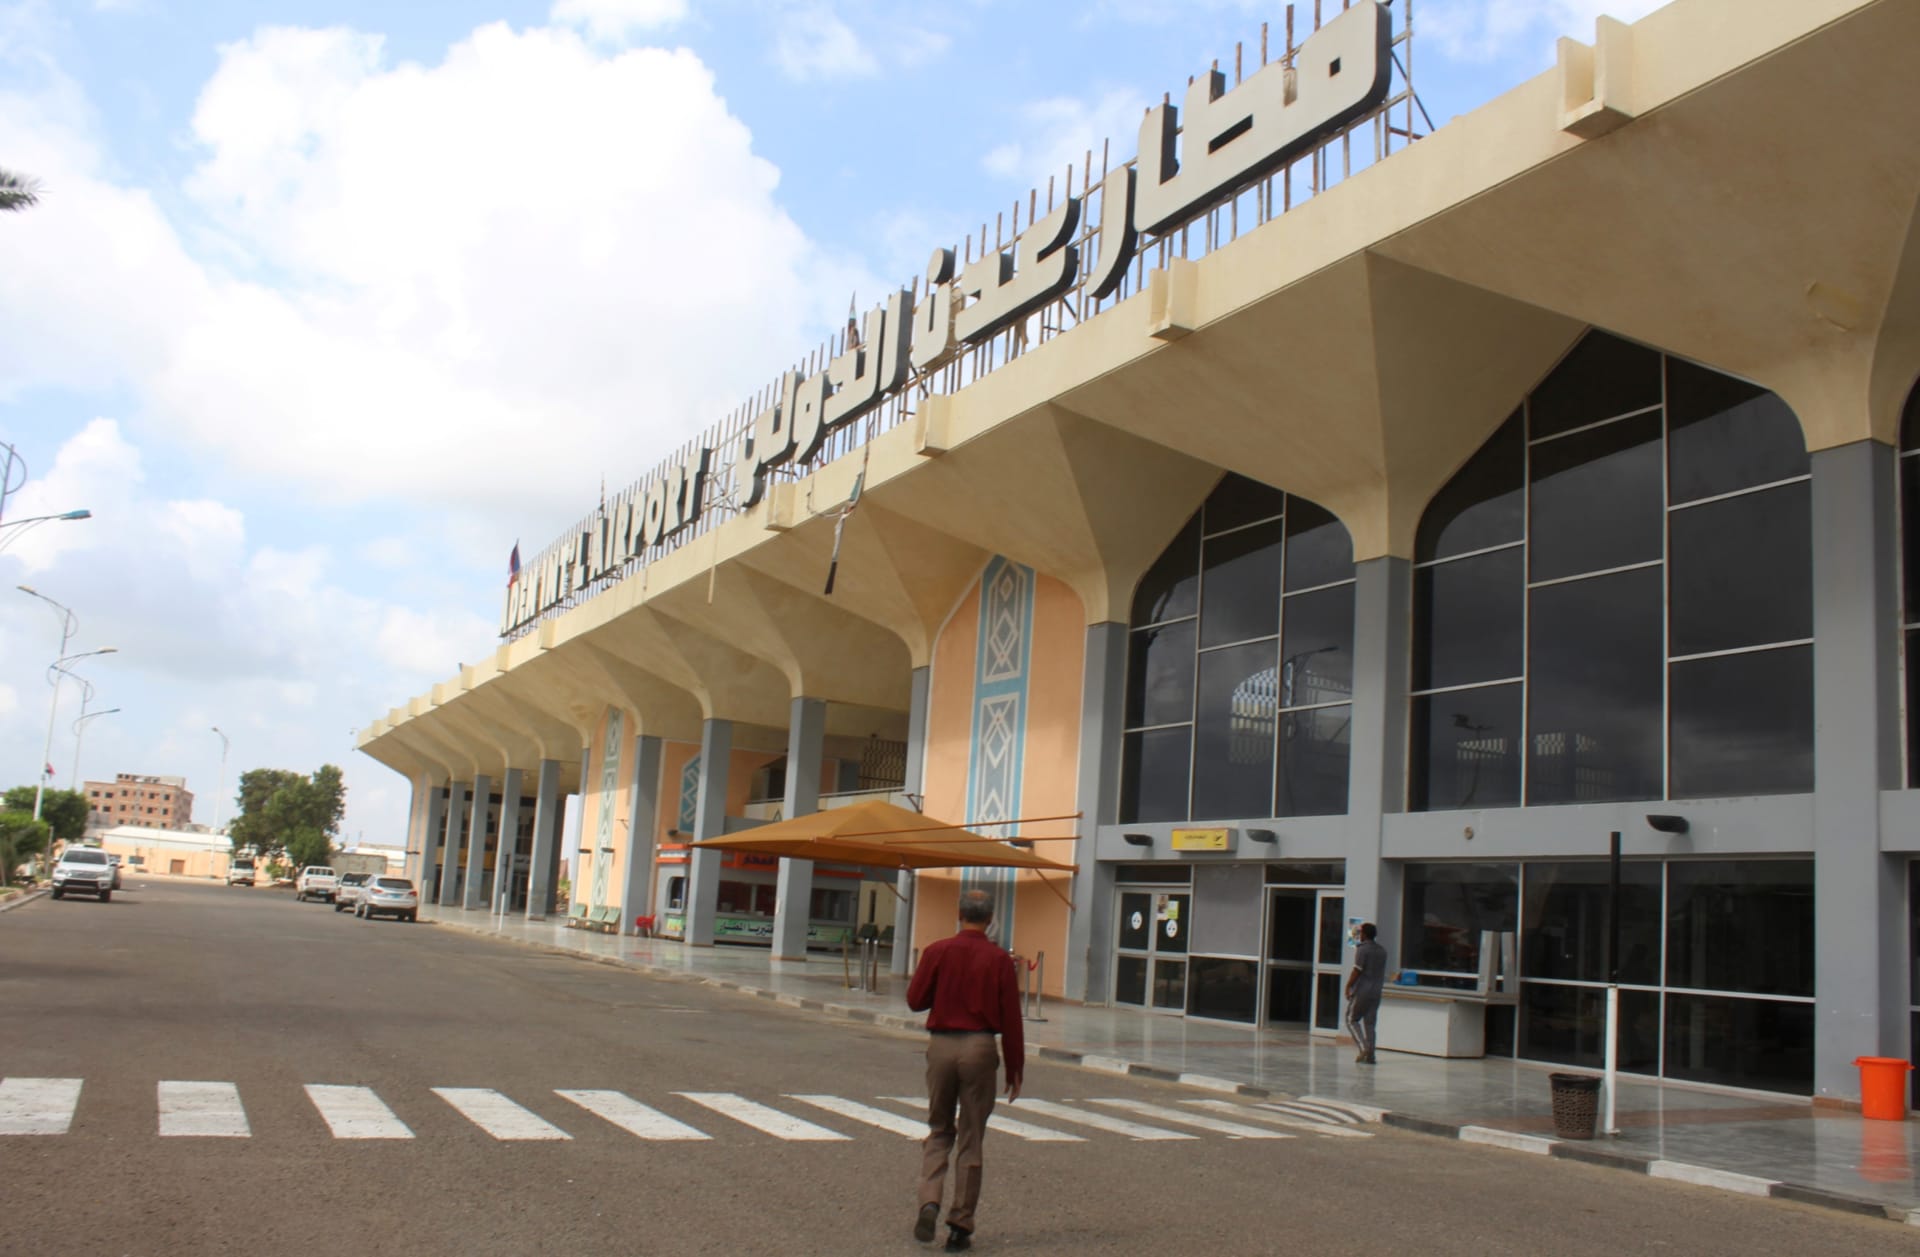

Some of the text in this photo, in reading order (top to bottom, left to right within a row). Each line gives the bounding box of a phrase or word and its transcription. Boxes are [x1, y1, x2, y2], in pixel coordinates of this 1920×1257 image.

[737, 0, 1392, 508] مطار عدن الدولي
[587, 448, 711, 581] AIRPORT
